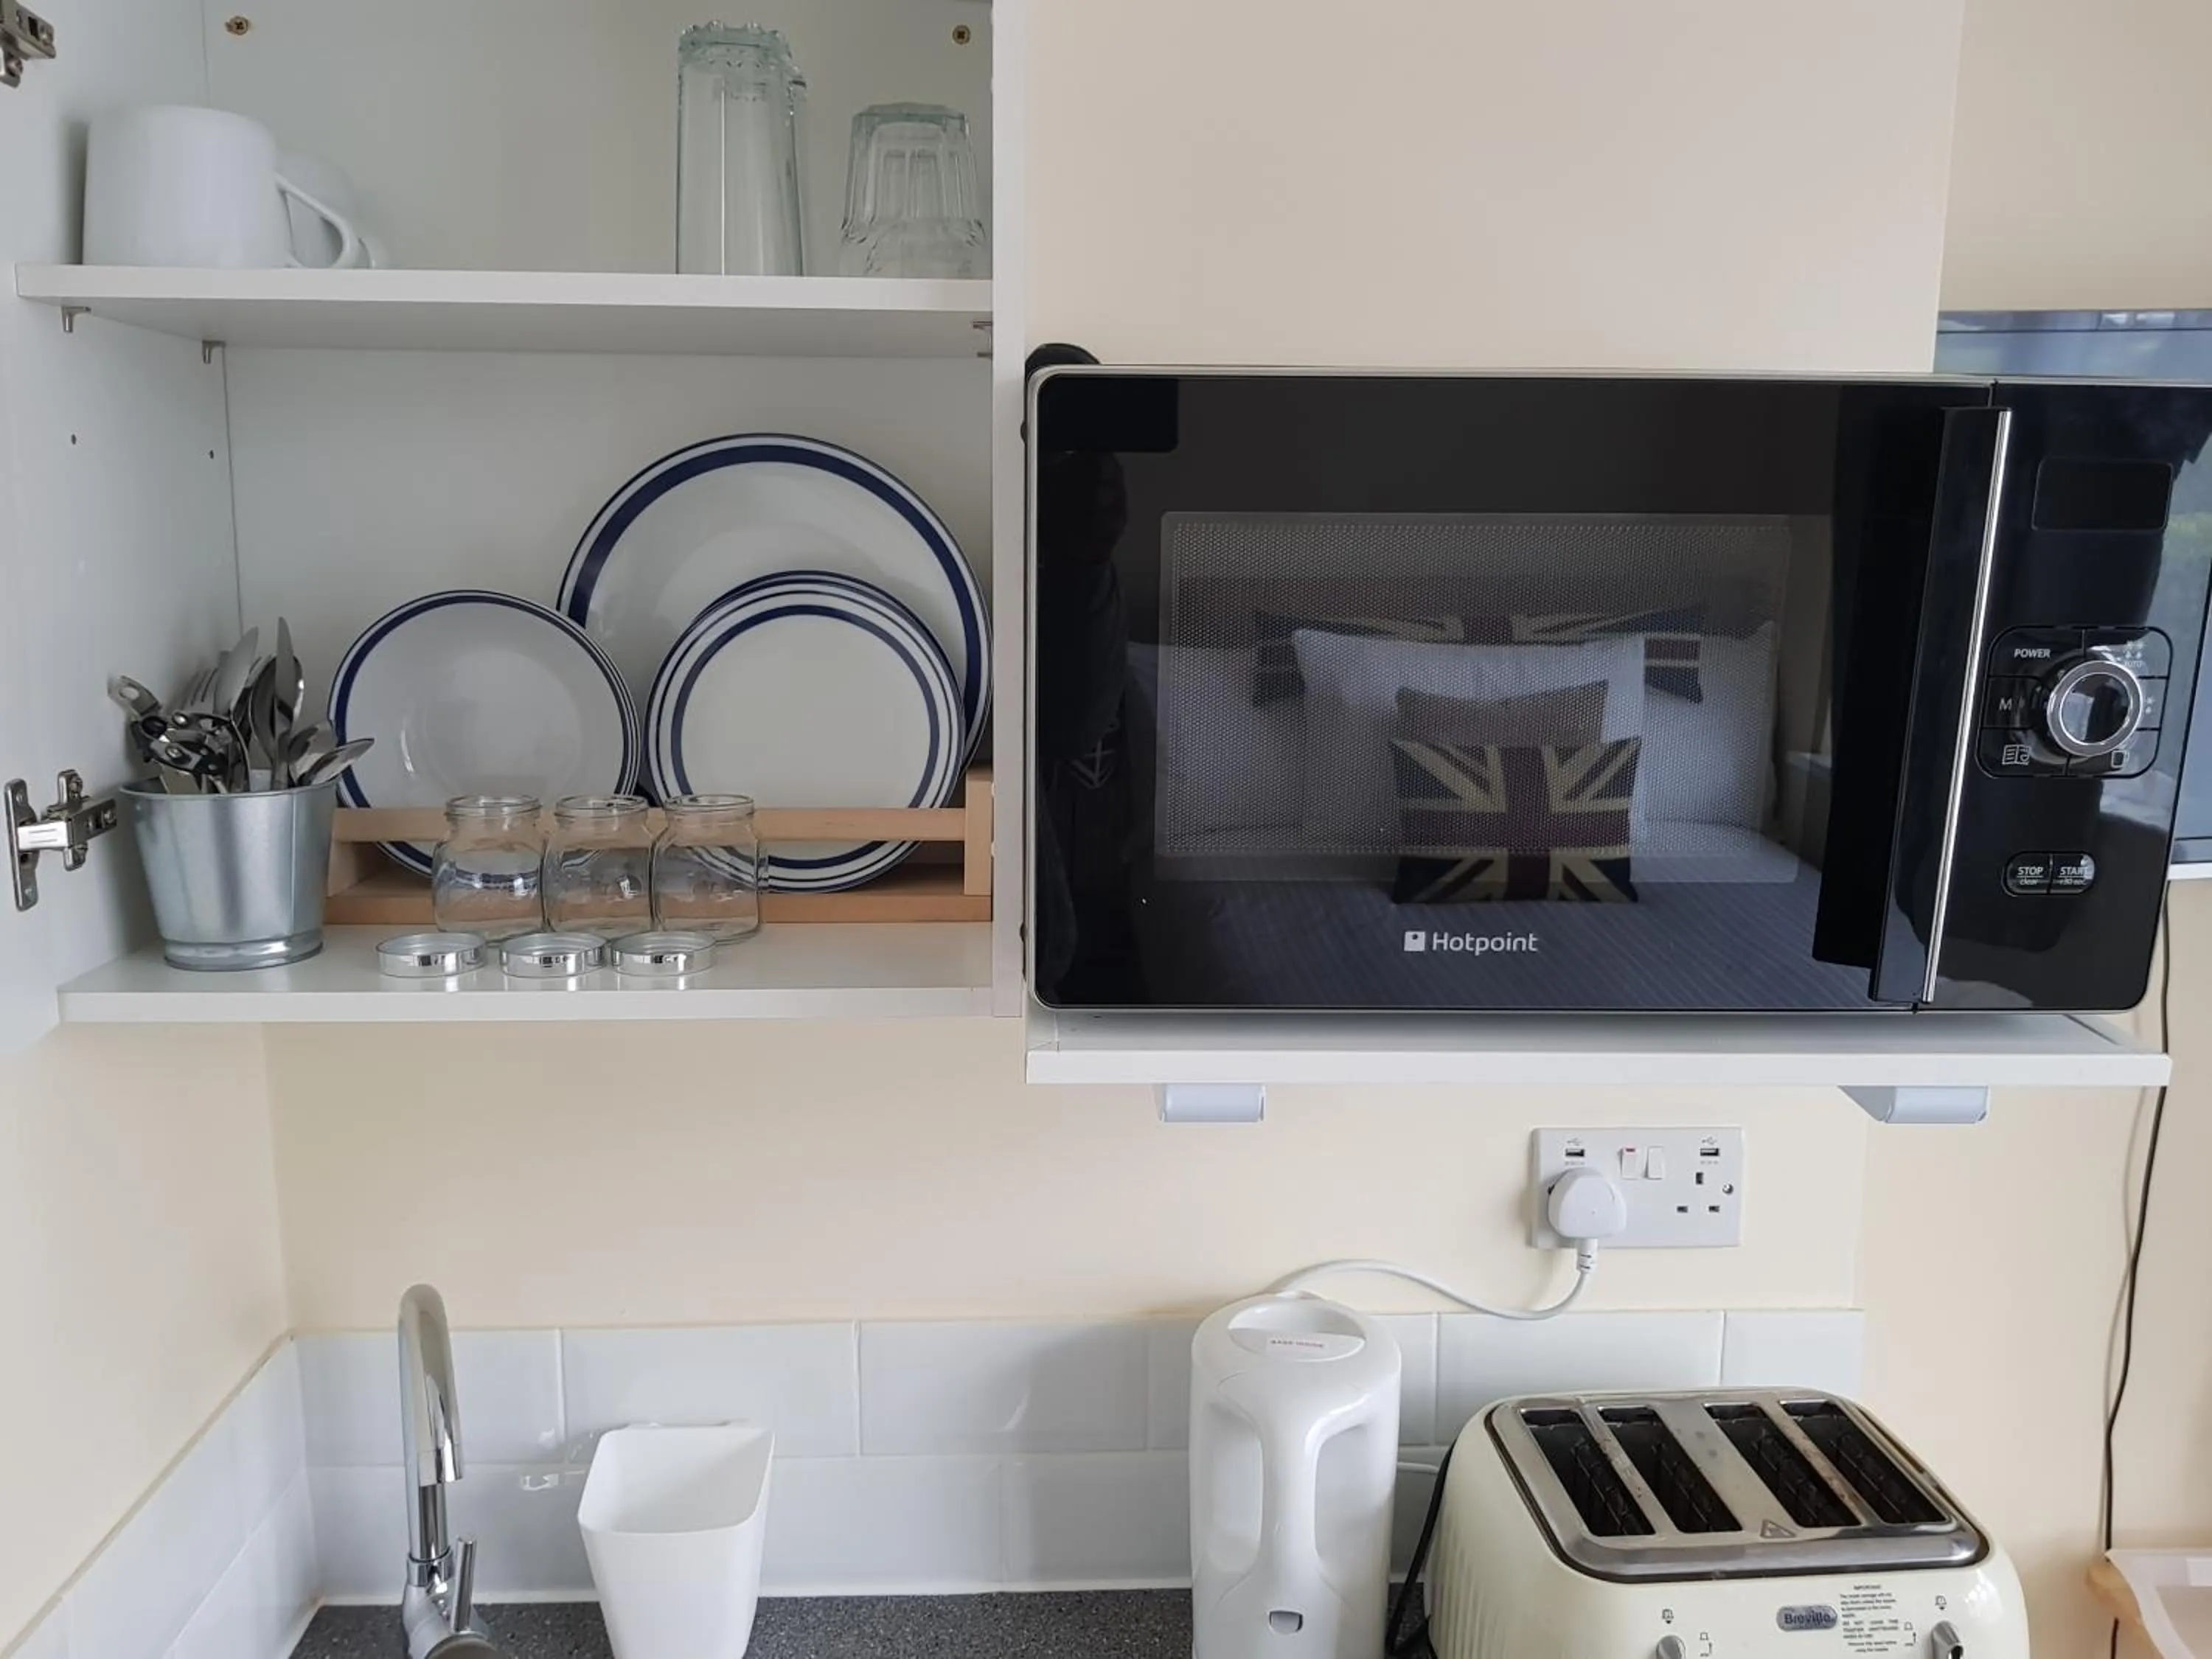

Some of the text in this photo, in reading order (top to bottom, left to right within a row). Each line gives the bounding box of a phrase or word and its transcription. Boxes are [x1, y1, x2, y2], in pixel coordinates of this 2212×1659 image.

[2014, 648, 2051, 658] POWER
[2017, 866, 2043, 875] STOP
[1433, 931, 1539, 956] Hotpoint
